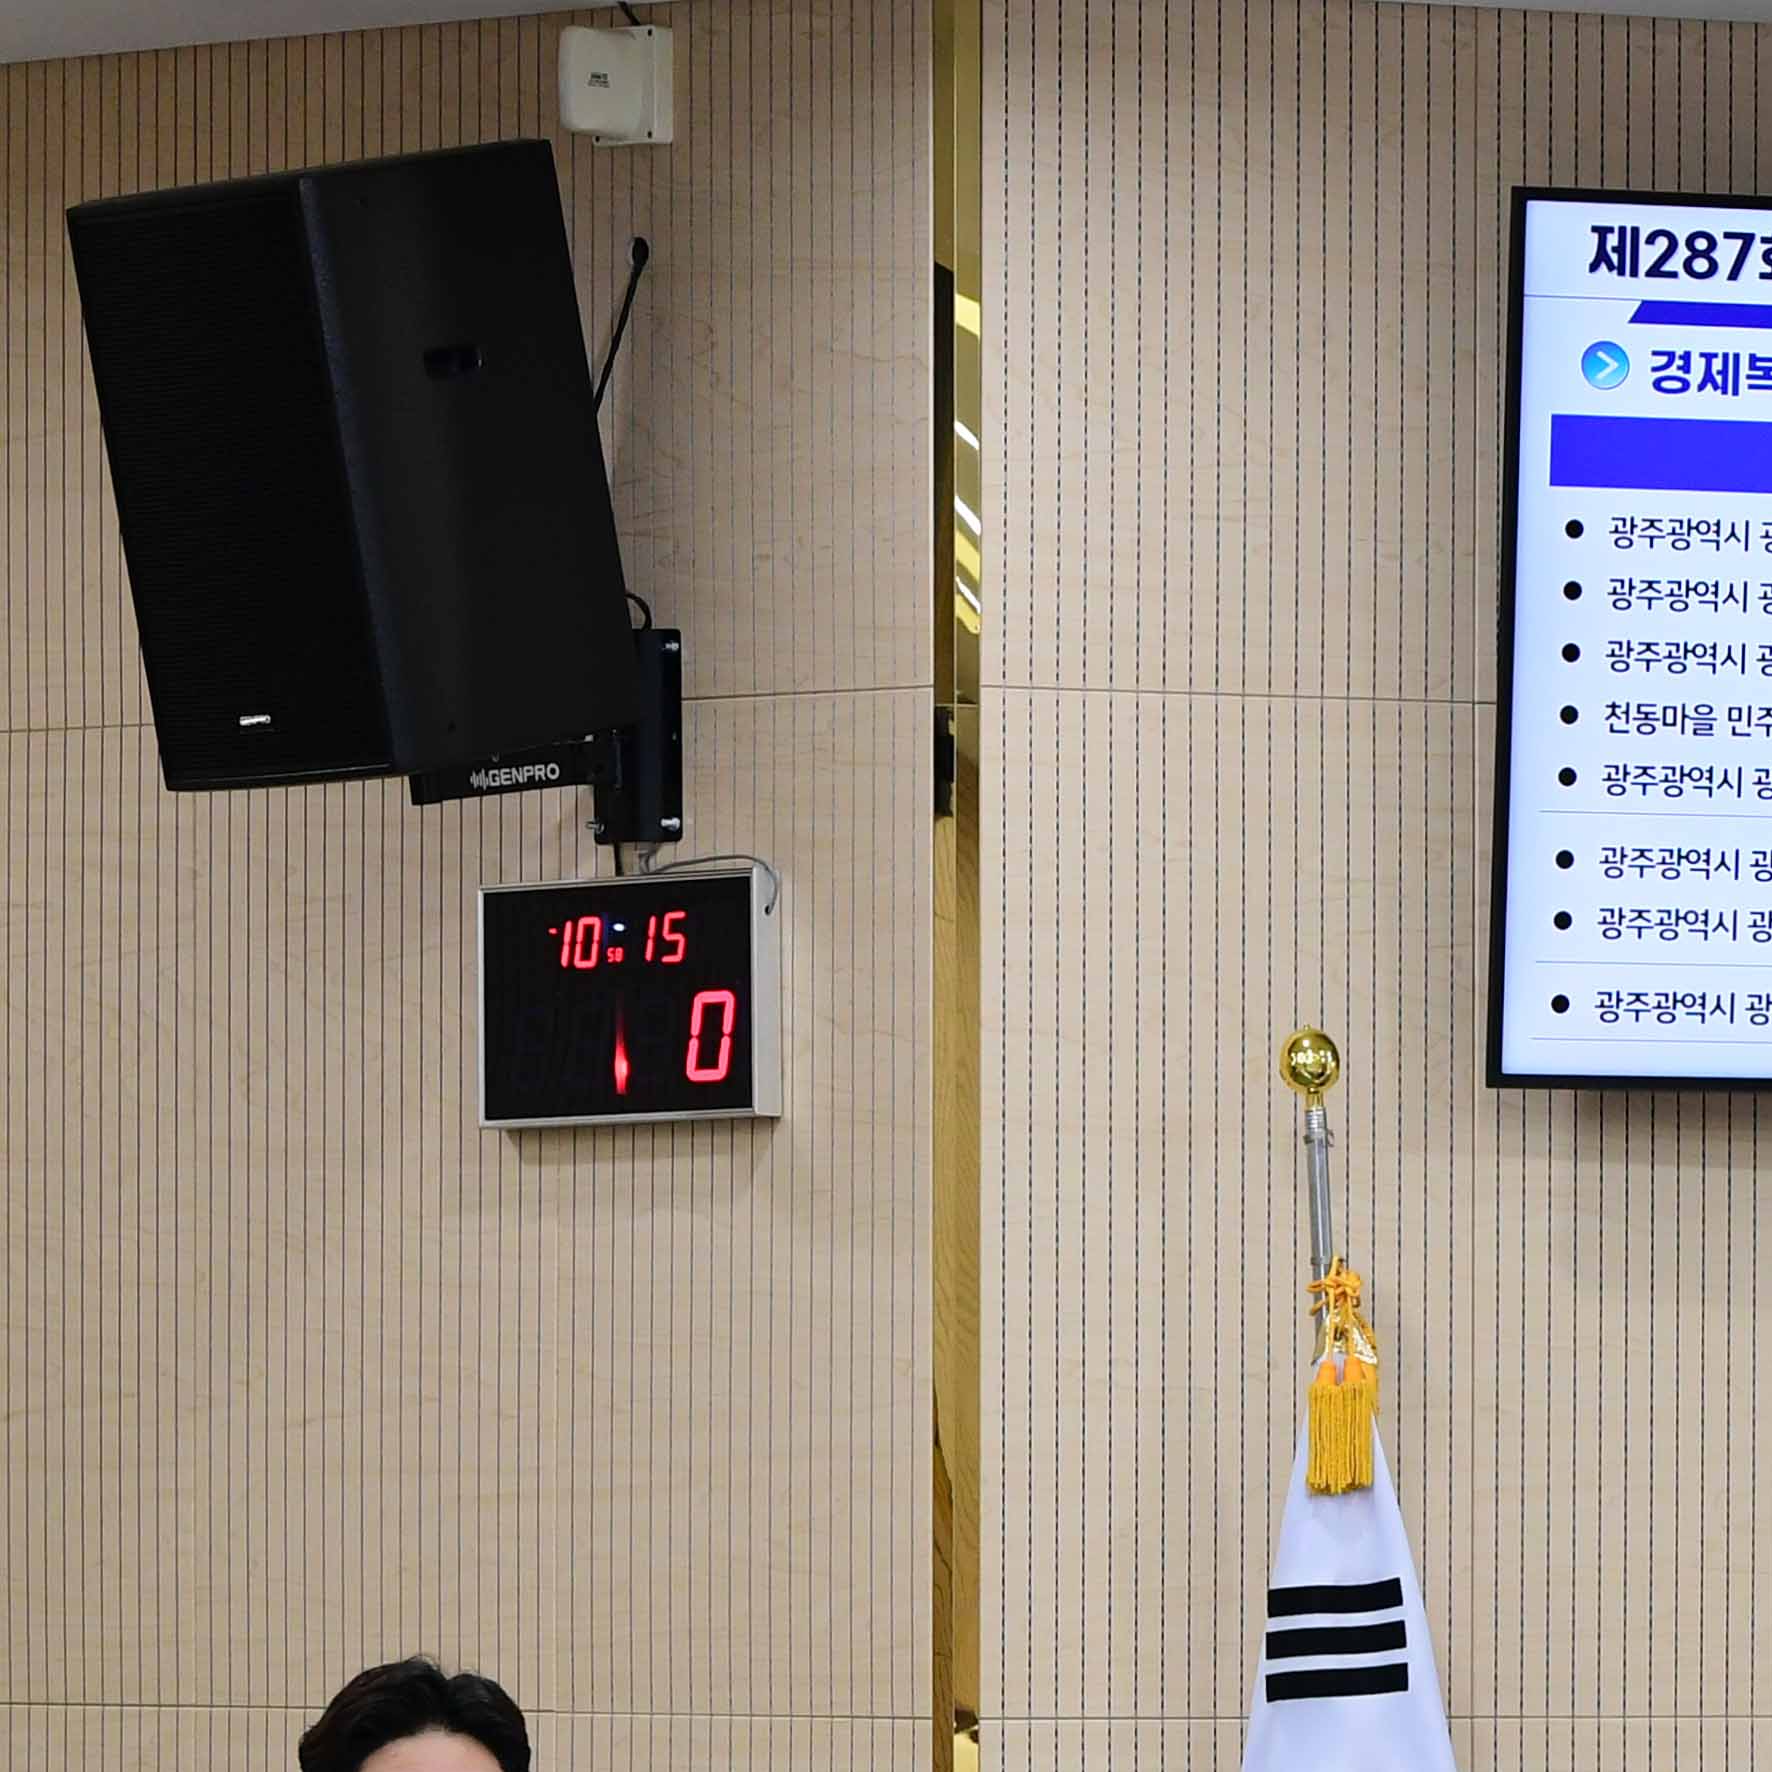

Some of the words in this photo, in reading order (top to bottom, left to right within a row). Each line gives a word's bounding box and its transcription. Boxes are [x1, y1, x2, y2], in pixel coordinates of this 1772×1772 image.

[1608, 515, 1750, 552] 광주광역시
[1607, 577, 1748, 614] 광주광역시
[1605, 639, 1746, 675] 광주광역시
[1604, 701, 1718, 737] 천동마을
[488, 763, 560, 787] GENPRO
[1601, 763, 1743, 799] 광주광역시
[1599, 846, 1740, 881] 광주광역시
[1597, 907, 1738, 942] 광주광역시
[1594, 990, 1735, 1025] 광주광역시
[686, 990, 735, 1082] 0
